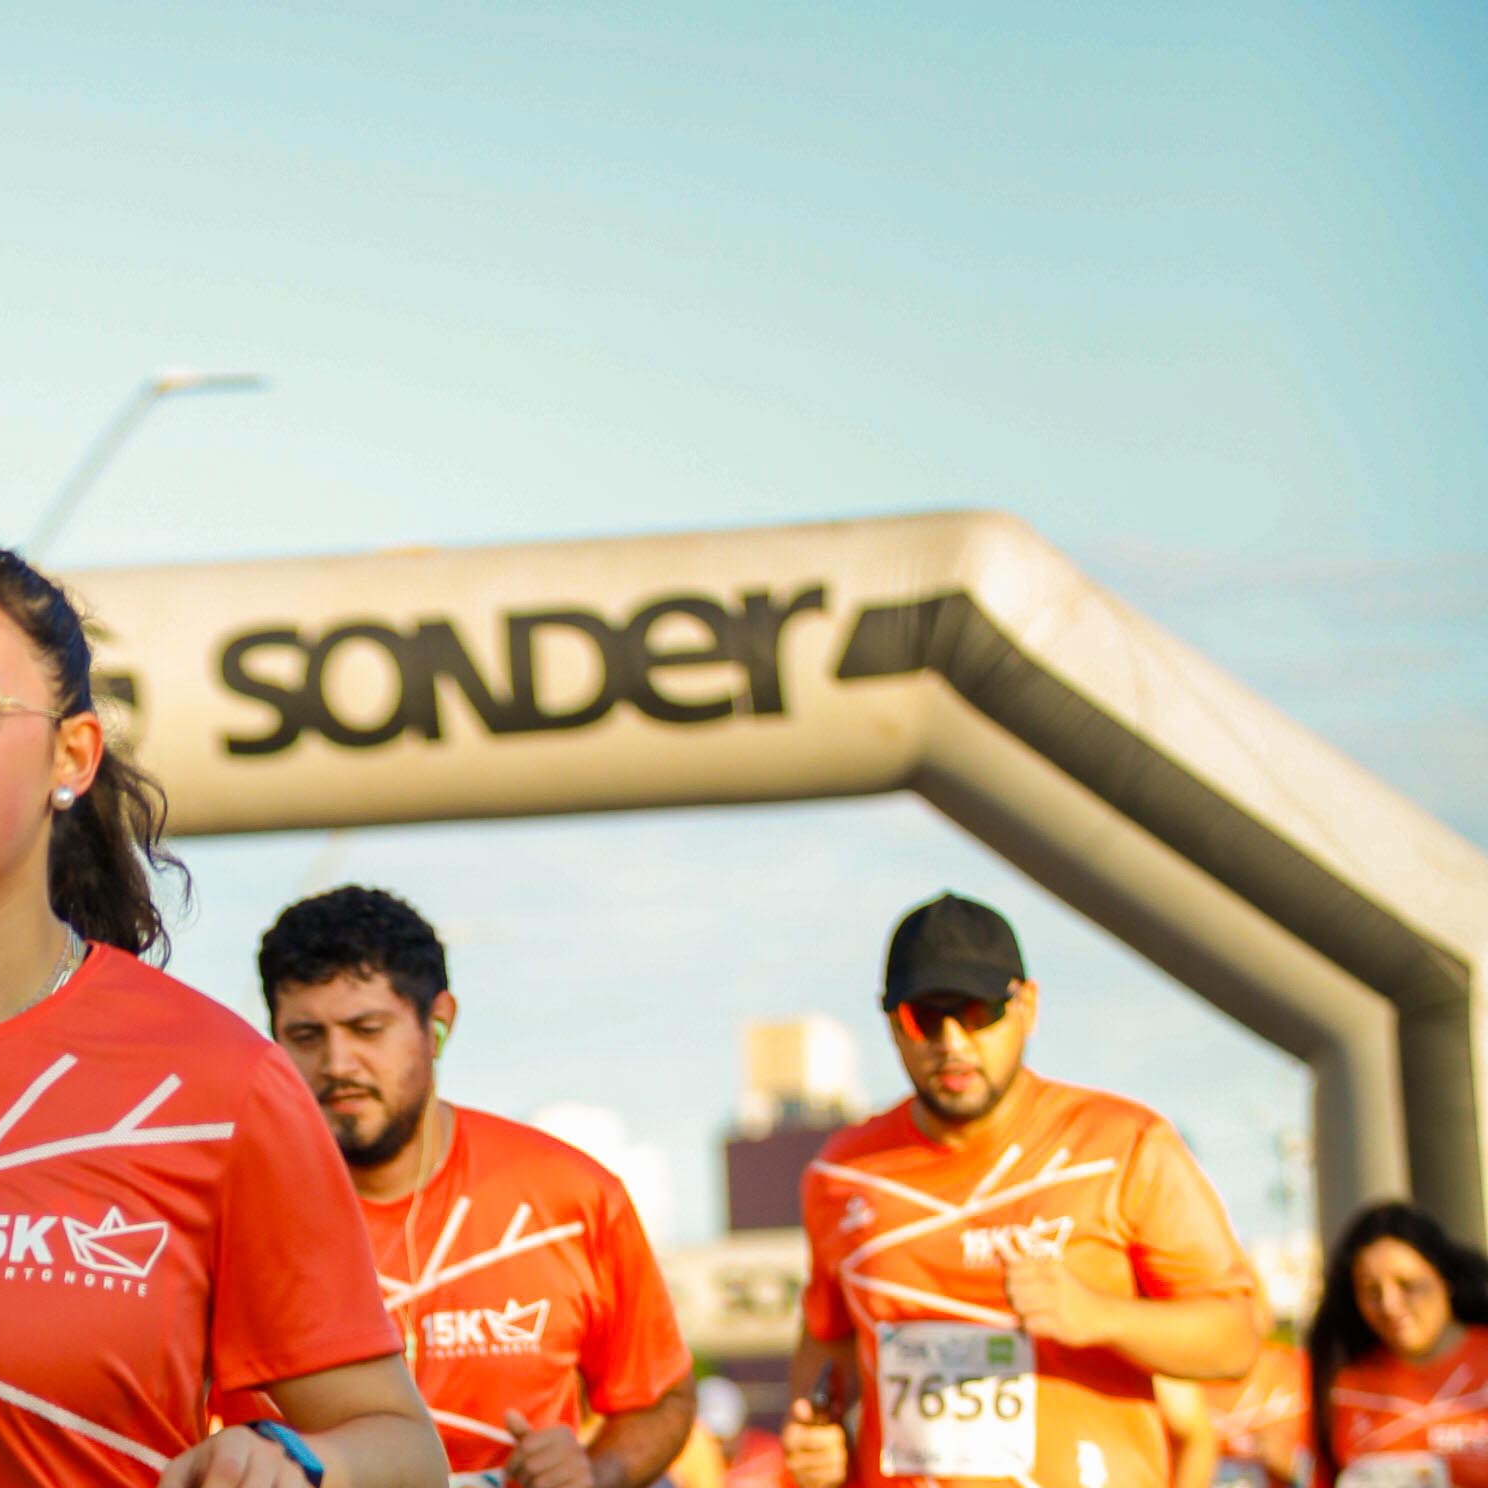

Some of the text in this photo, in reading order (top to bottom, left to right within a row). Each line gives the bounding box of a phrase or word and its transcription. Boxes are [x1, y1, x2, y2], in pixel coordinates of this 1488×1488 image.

[64, 1271, 148, 1297] NORTE
[421, 1309, 486, 1347] 15K
[886, 1373, 1023, 1421] 7656
